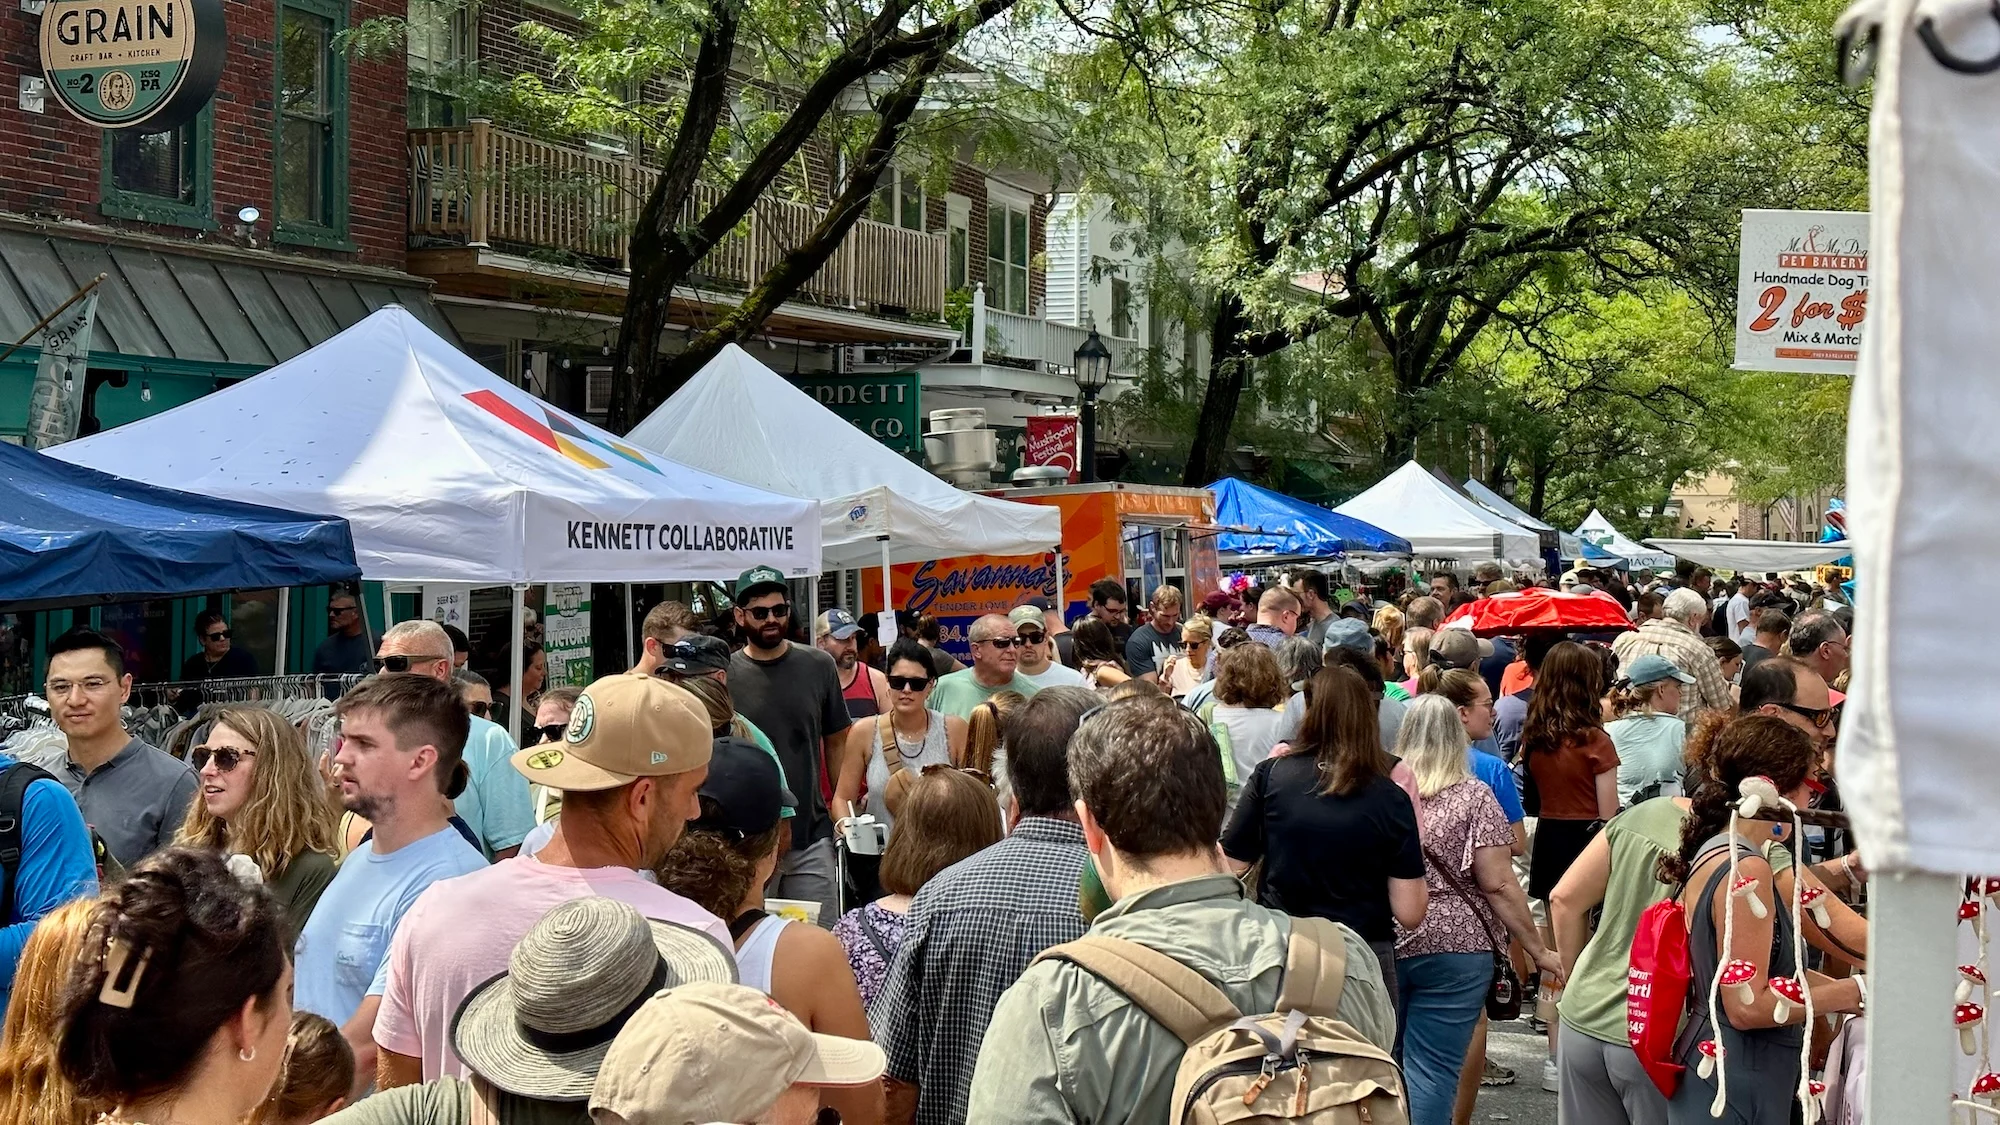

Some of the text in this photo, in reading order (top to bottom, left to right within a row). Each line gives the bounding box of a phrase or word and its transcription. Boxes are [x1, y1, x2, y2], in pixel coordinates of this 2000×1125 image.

[56, 2, 174, 46] GRAIN
[70, 54, 93, 62] CRAFT
[98, 52, 113, 60] BAR
[127, 48, 161, 58] KITCHEN
[80, 73, 94, 94] 2
[140, 69, 161, 79] KSQ
[140, 78, 161, 91] PA
[1817, 238, 1841, 260] My
[1781, 255, 1867, 269] PET BAKERY
[1753, 271, 1825, 285] Handmade
[1828, 274, 1855, 290] Dog
[1748, 285, 1787, 332] 2
[1791, 291, 1835, 329] for
[49, 309, 88, 348] GRAIN
[1782, 330, 1808, 343] Mix
[1811, 331, 1821, 344] &
[1028, 423, 1075, 452] Mushroom
[1032, 439, 1064, 462] Festival
[567, 520, 794, 551] KENNETT COLLABORATIVE
[933, 601, 1008, 612] TENDER LOVE
[547, 627, 591, 648] VICTORY
